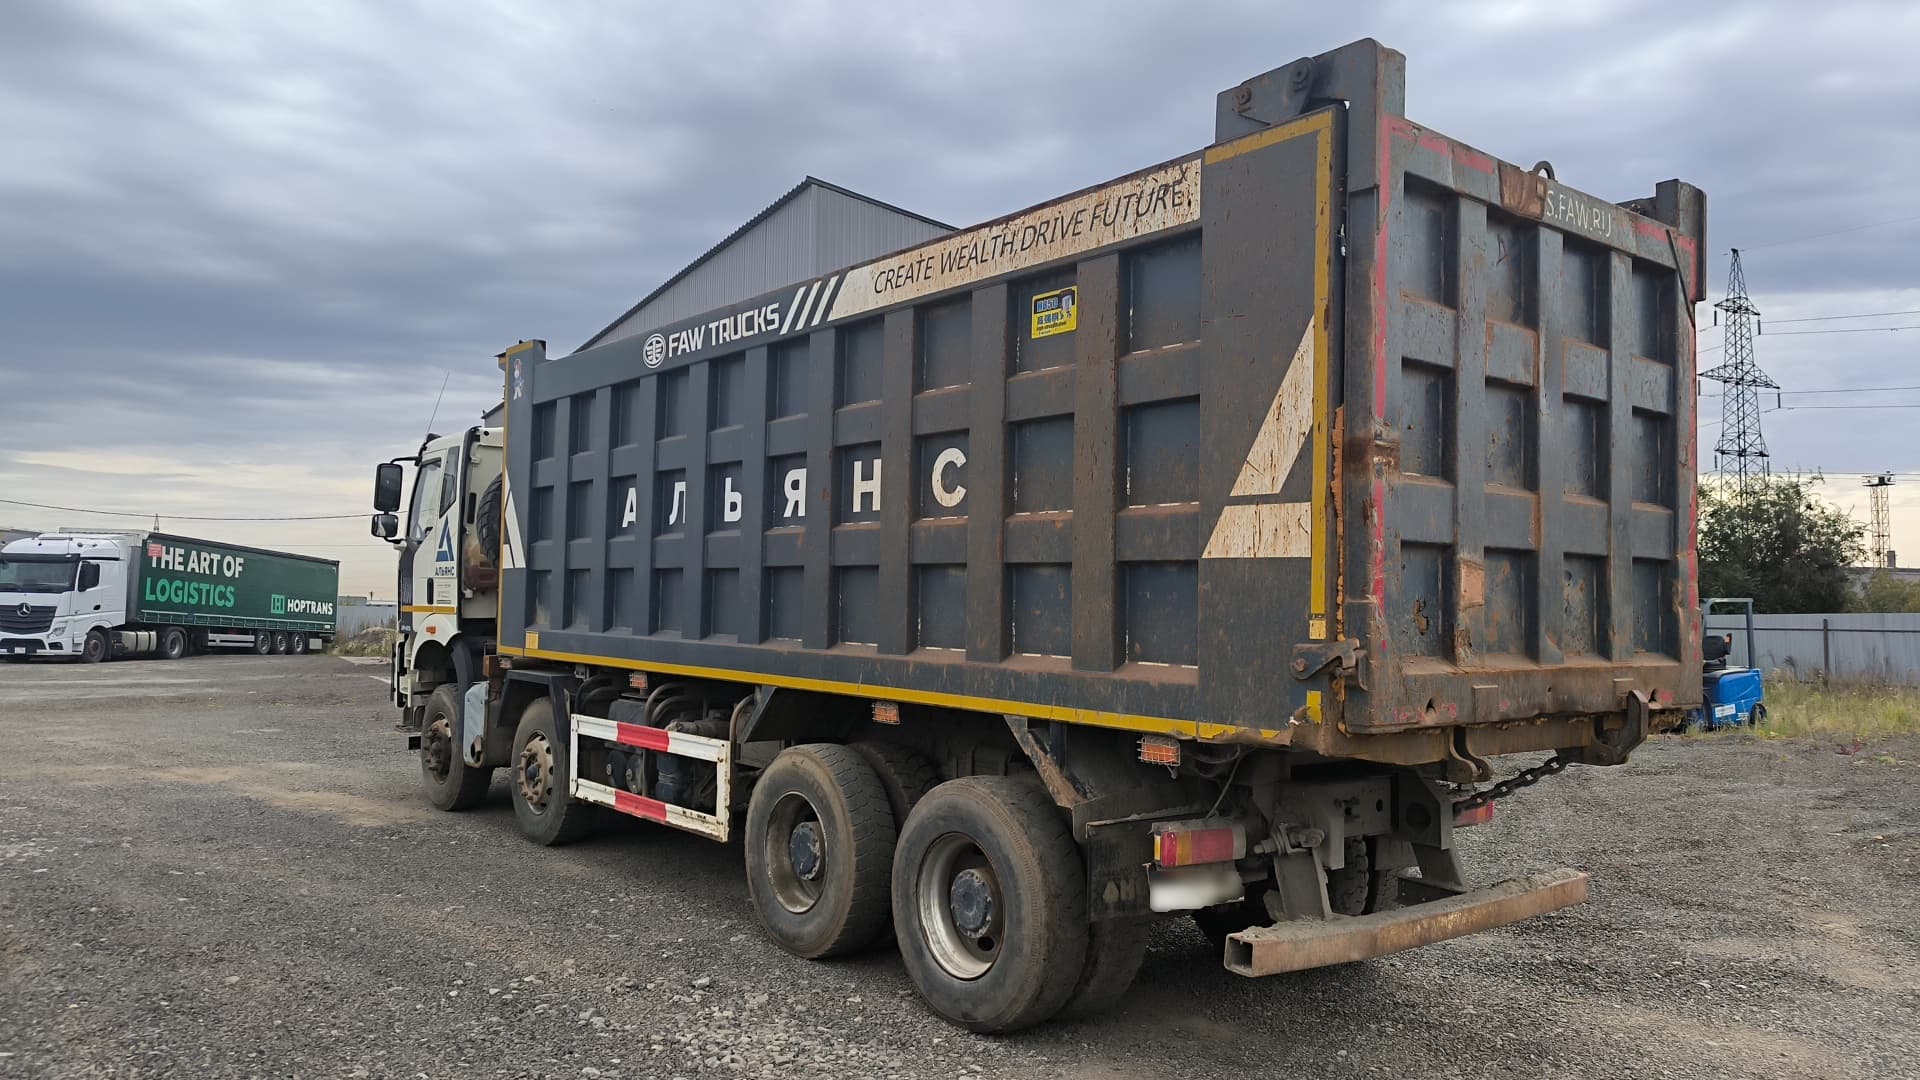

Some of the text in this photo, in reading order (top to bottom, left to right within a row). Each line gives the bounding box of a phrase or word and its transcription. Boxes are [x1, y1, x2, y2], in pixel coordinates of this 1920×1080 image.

[874, 254, 935, 294] CREATE
[668, 302, 780, 358] FAW TRUCKS
[187, 550, 221, 576] ART
[222, 555, 245, 578] OF
[145, 577, 235, 608] LOGISTICS
[287, 598, 333, 615] HOPTRANS
